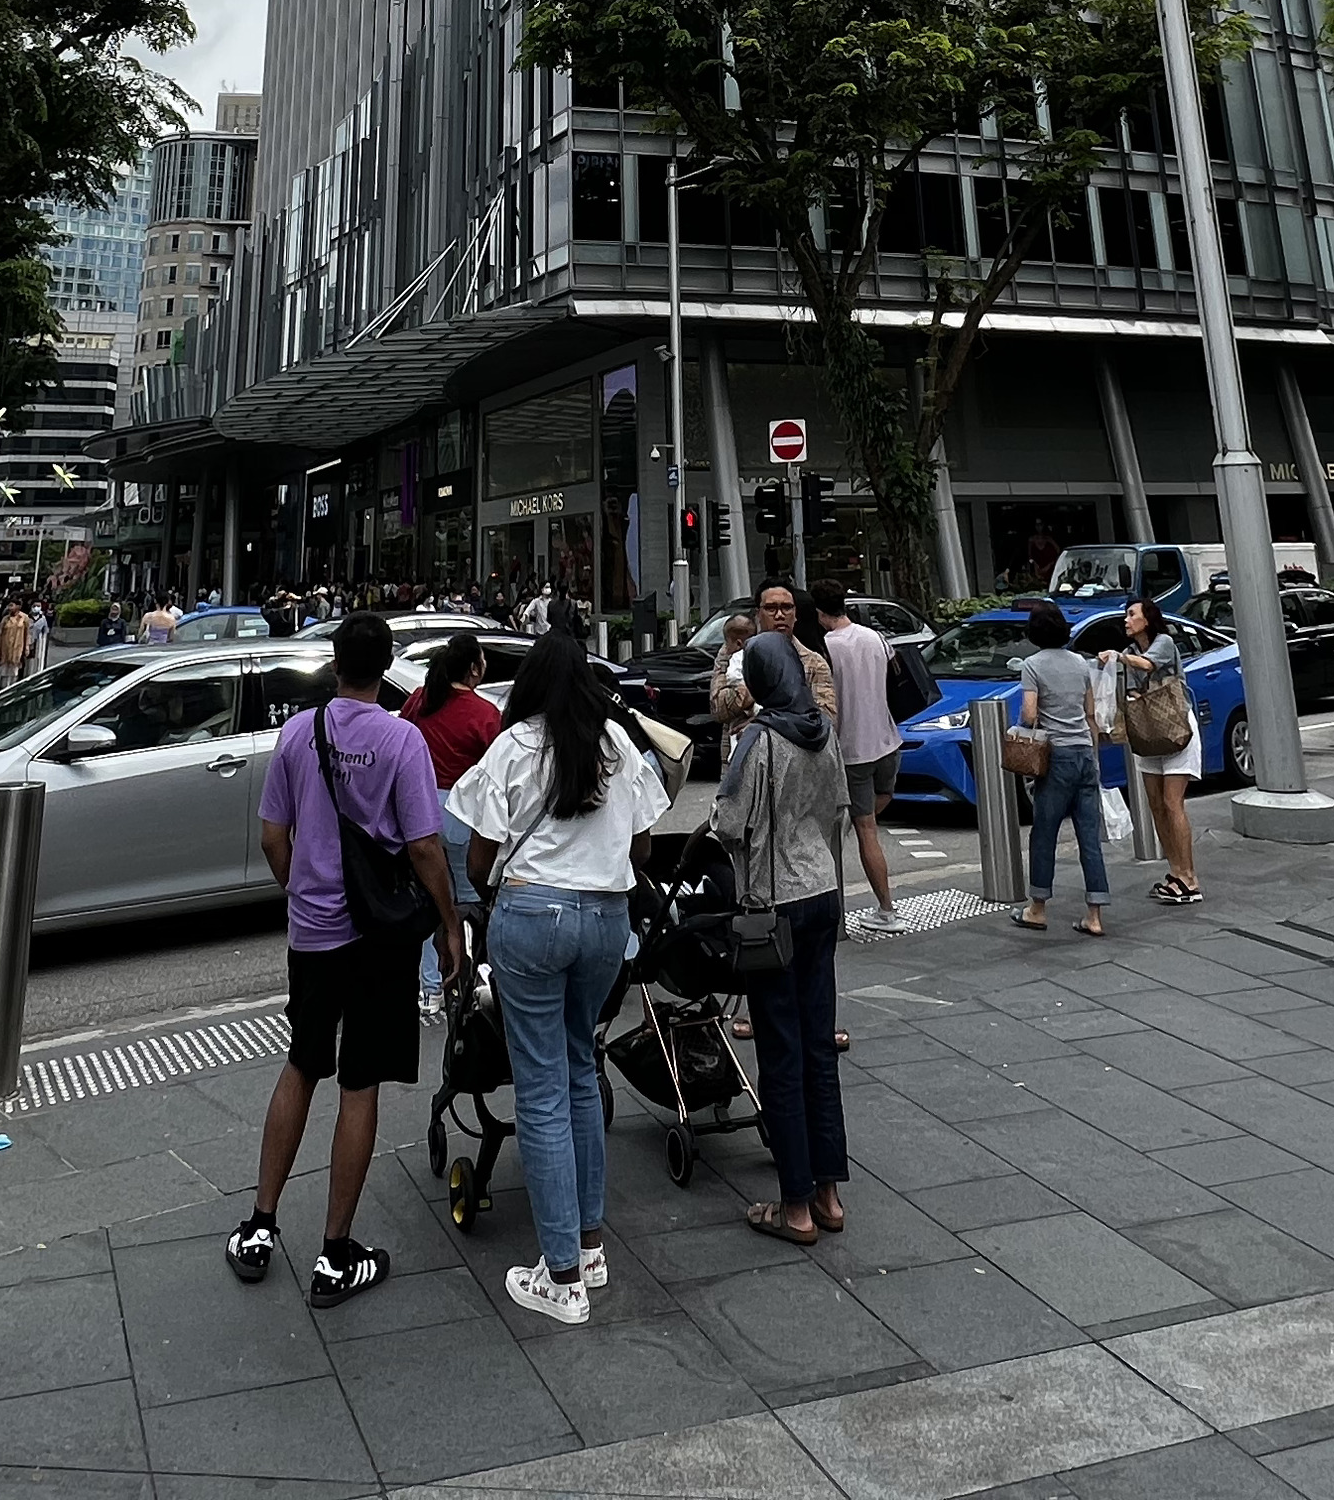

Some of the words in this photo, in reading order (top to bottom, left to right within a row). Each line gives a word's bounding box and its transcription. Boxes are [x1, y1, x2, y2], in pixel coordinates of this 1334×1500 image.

[312, 493, 329, 519] BOSS
[510, 496, 541, 517] MICHAEL
[542, 492, 564, 513] KORS
